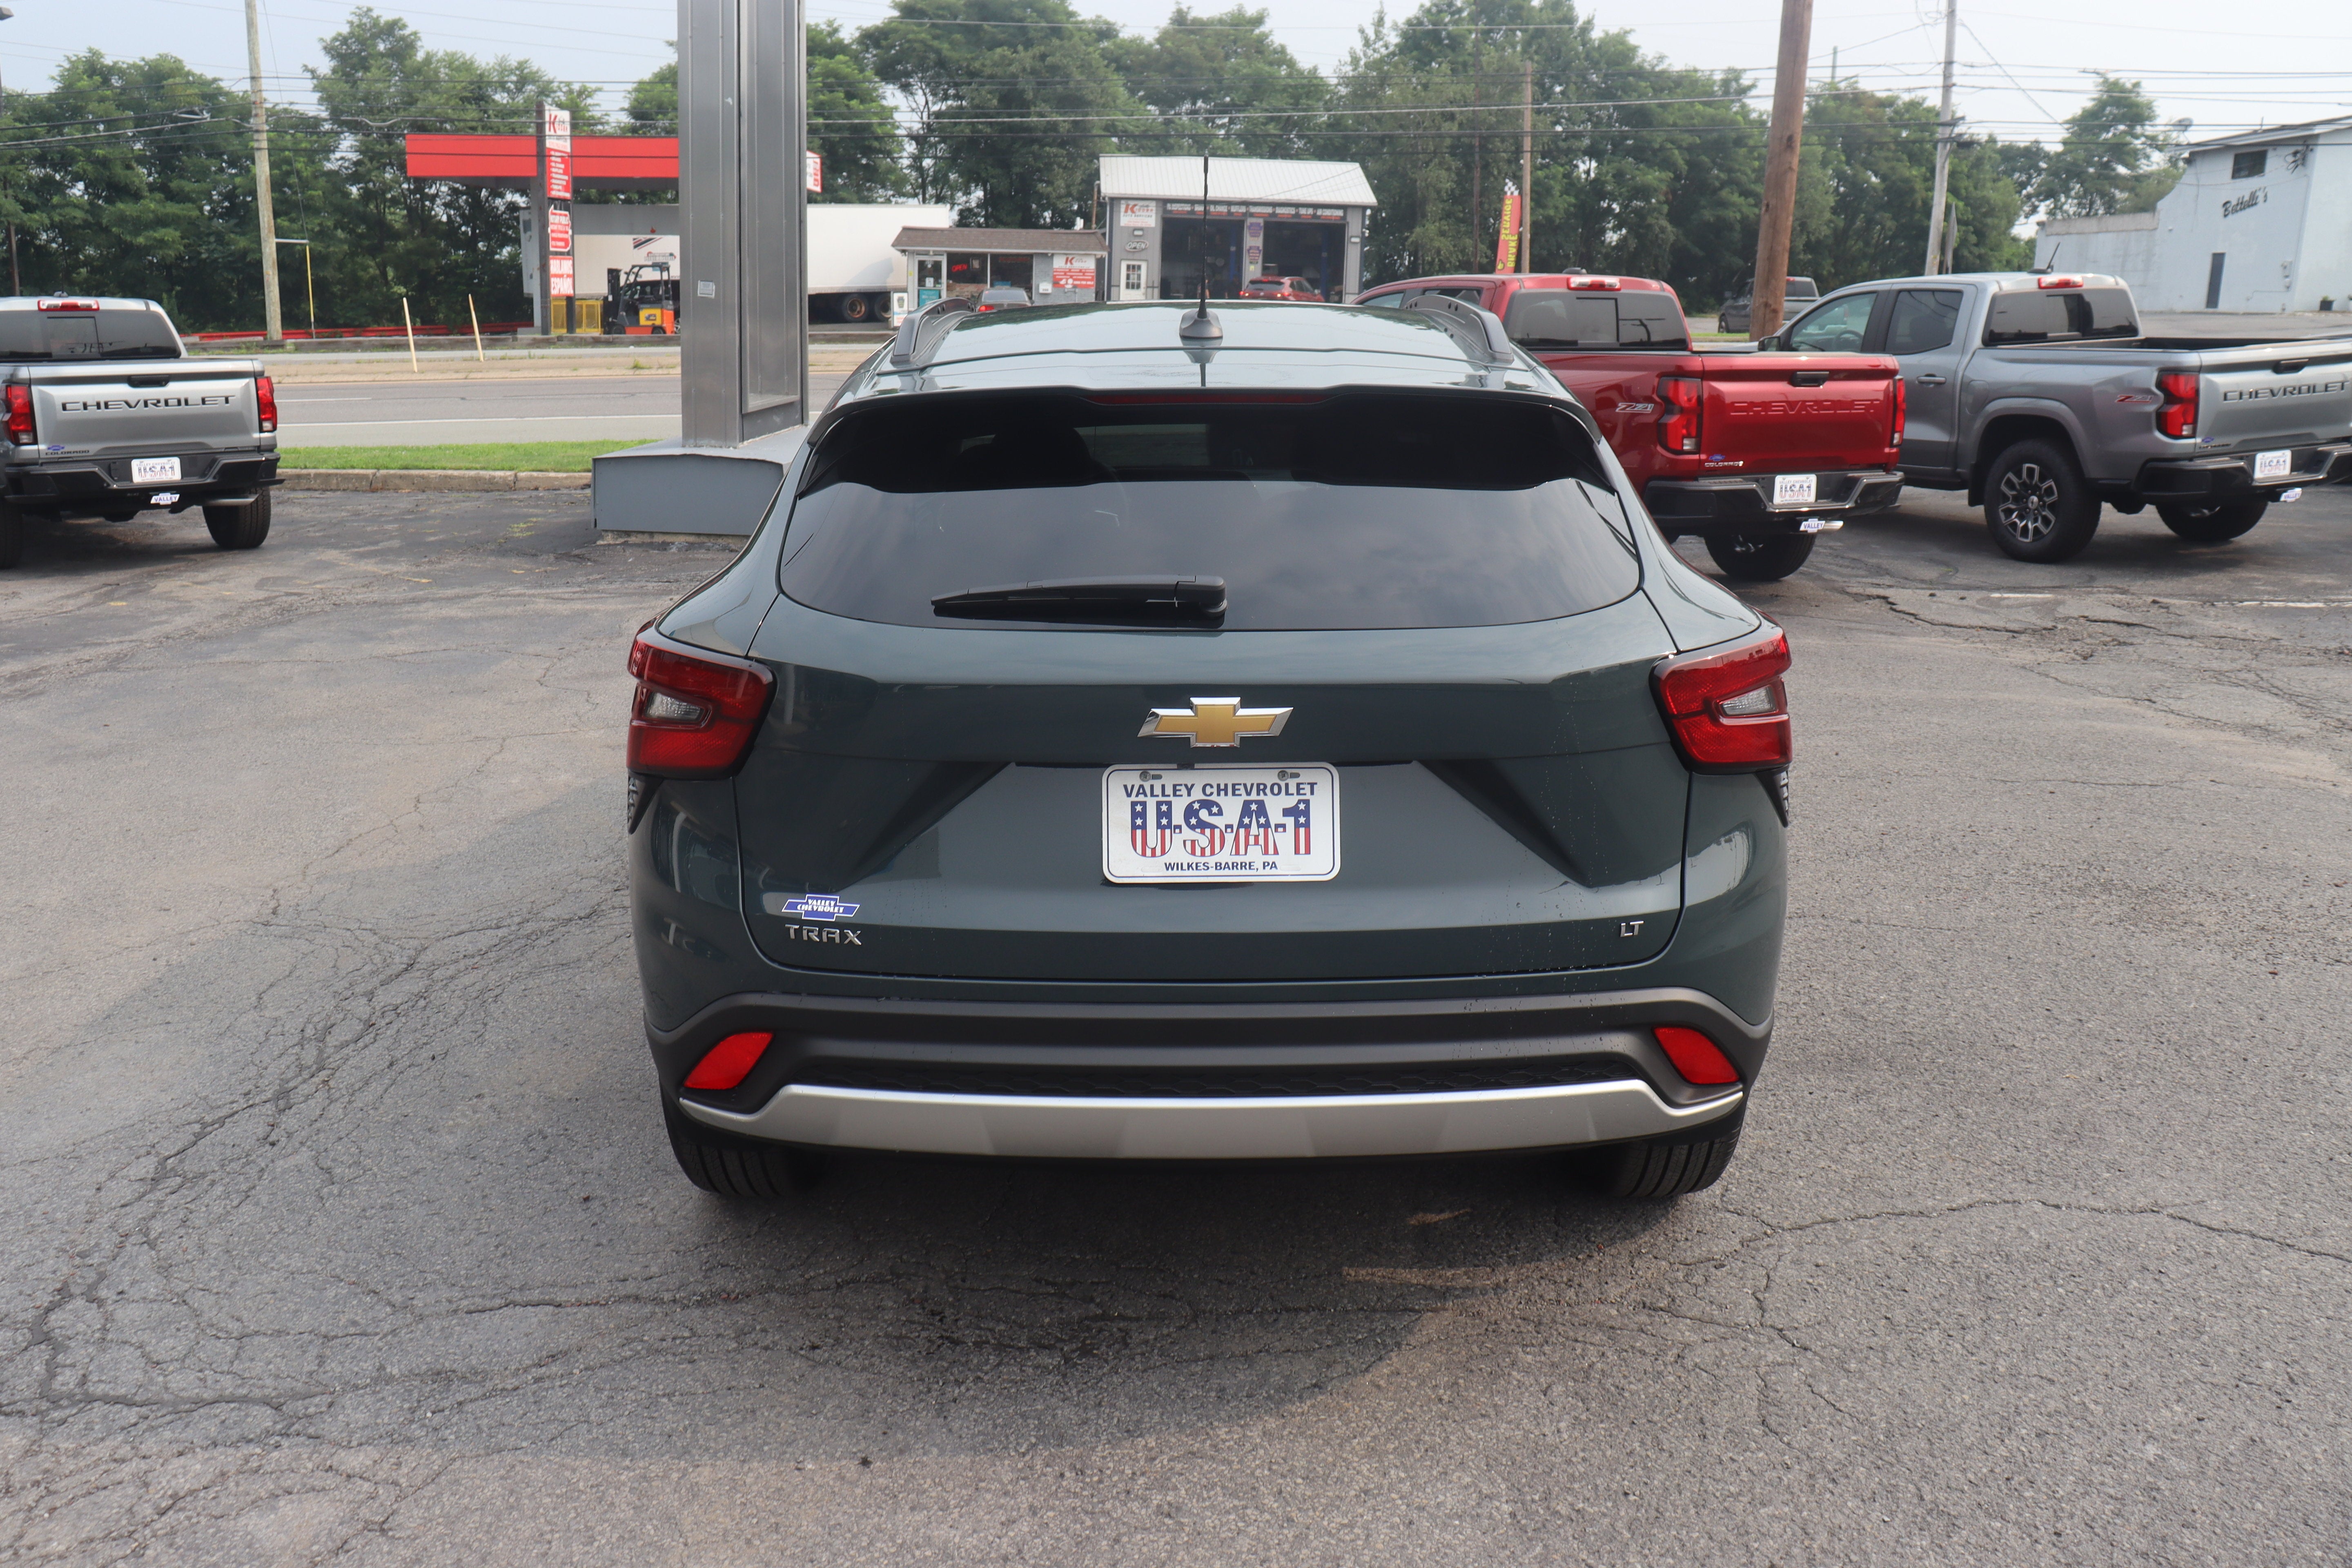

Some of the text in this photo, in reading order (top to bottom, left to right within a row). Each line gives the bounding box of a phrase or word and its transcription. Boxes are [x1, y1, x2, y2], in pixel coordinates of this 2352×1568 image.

[952, 264, 967, 272] OPEN
[2223, 380, 2350, 403] CHEVROLET
[61, 394, 236, 412] CHEVROLET
[1730, 401, 1880, 414] CHEVROLET
[1123, 782, 1318, 797] VALLEY CHEVROLET
[1165, 861, 1278, 872] WILKES-BARRE, PA
[797, 904, 844, 913] CHEVROLET
[785, 924, 862, 945] TRAX
[1620, 920, 1644, 938] LT
